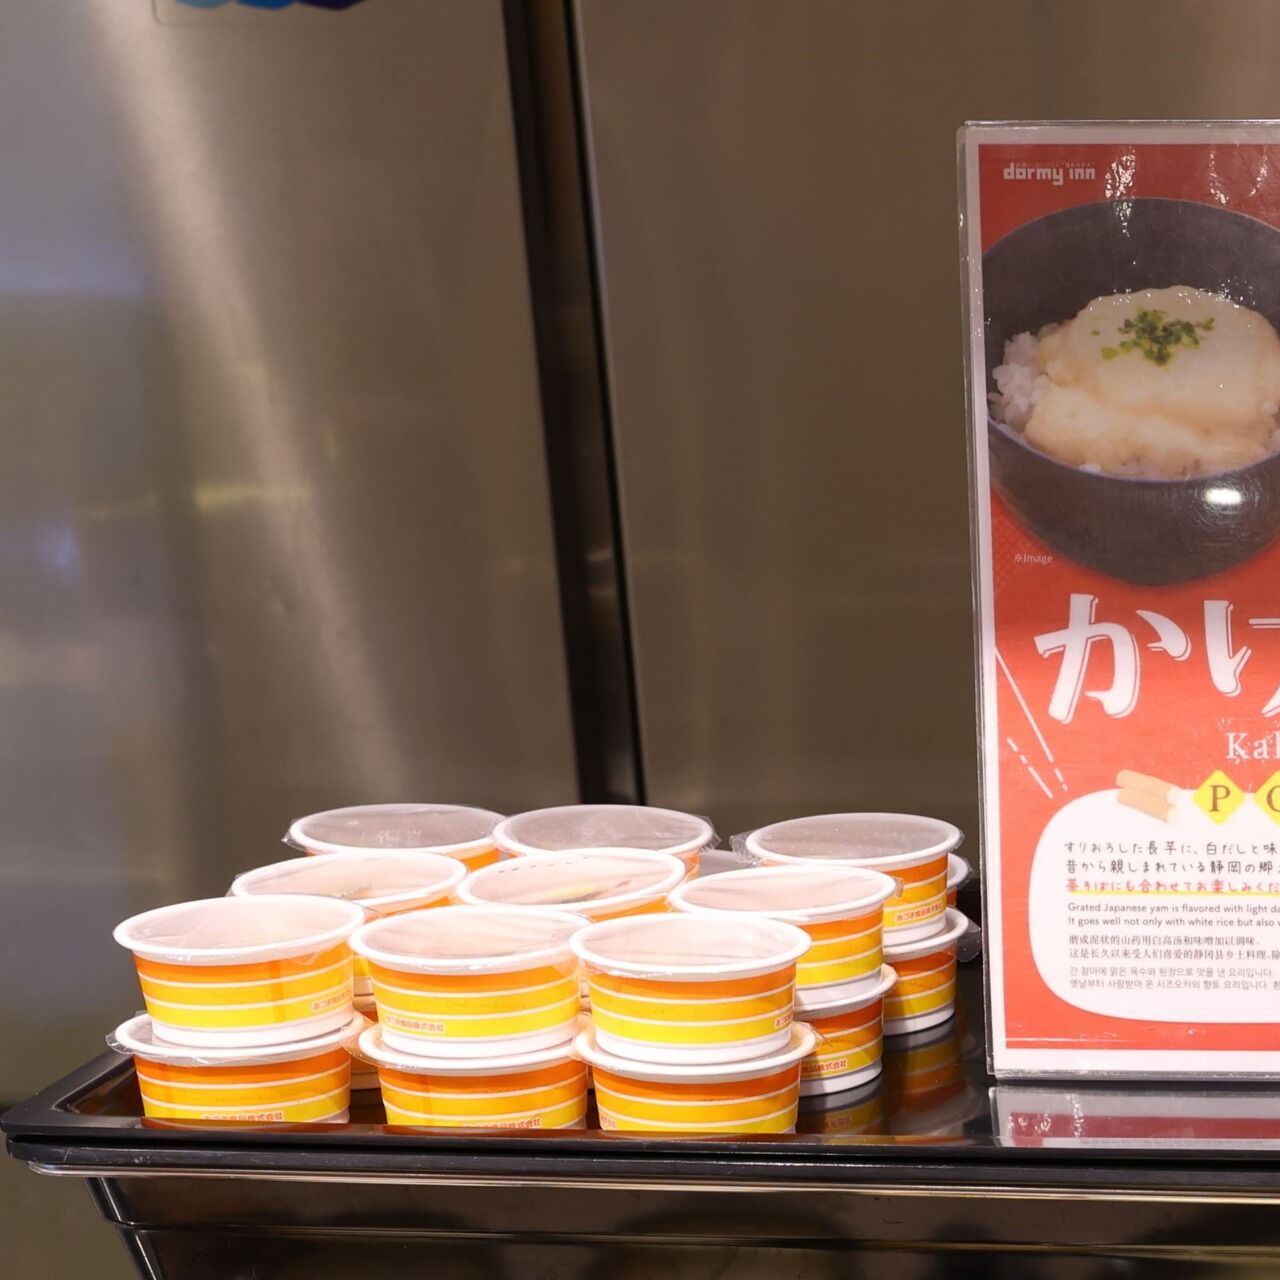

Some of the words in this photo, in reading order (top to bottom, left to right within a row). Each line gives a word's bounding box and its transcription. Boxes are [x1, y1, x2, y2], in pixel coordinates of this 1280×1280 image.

[1003, 162, 1064, 186] dormy
[1069, 166, 1096, 180] inn
[1067, 902, 1101, 912] Grated
[1103, 903, 1147, 914] Japanese
[1150, 905, 1169, 914] yam
[1172, 904, 1179, 912] is
[1182, 904, 1221, 913] flavored
[1223, 904, 1244, 913] with
[1246, 904, 1268, 915] light
[1068, 916, 1075, 925] It
[1078, 918, 1099, 927] goes
[1102, 917, 1121, 925] well
[1124, 917, 1140, 925] not
[1142, 917, 1163, 928] only
[1165, 917, 1186, 926] with
[1188, 918, 1213, 926] white
[1216, 918, 1235, 926] rice
[1237, 918, 1253, 927] but
[1256, 918, 1275, 927] also
